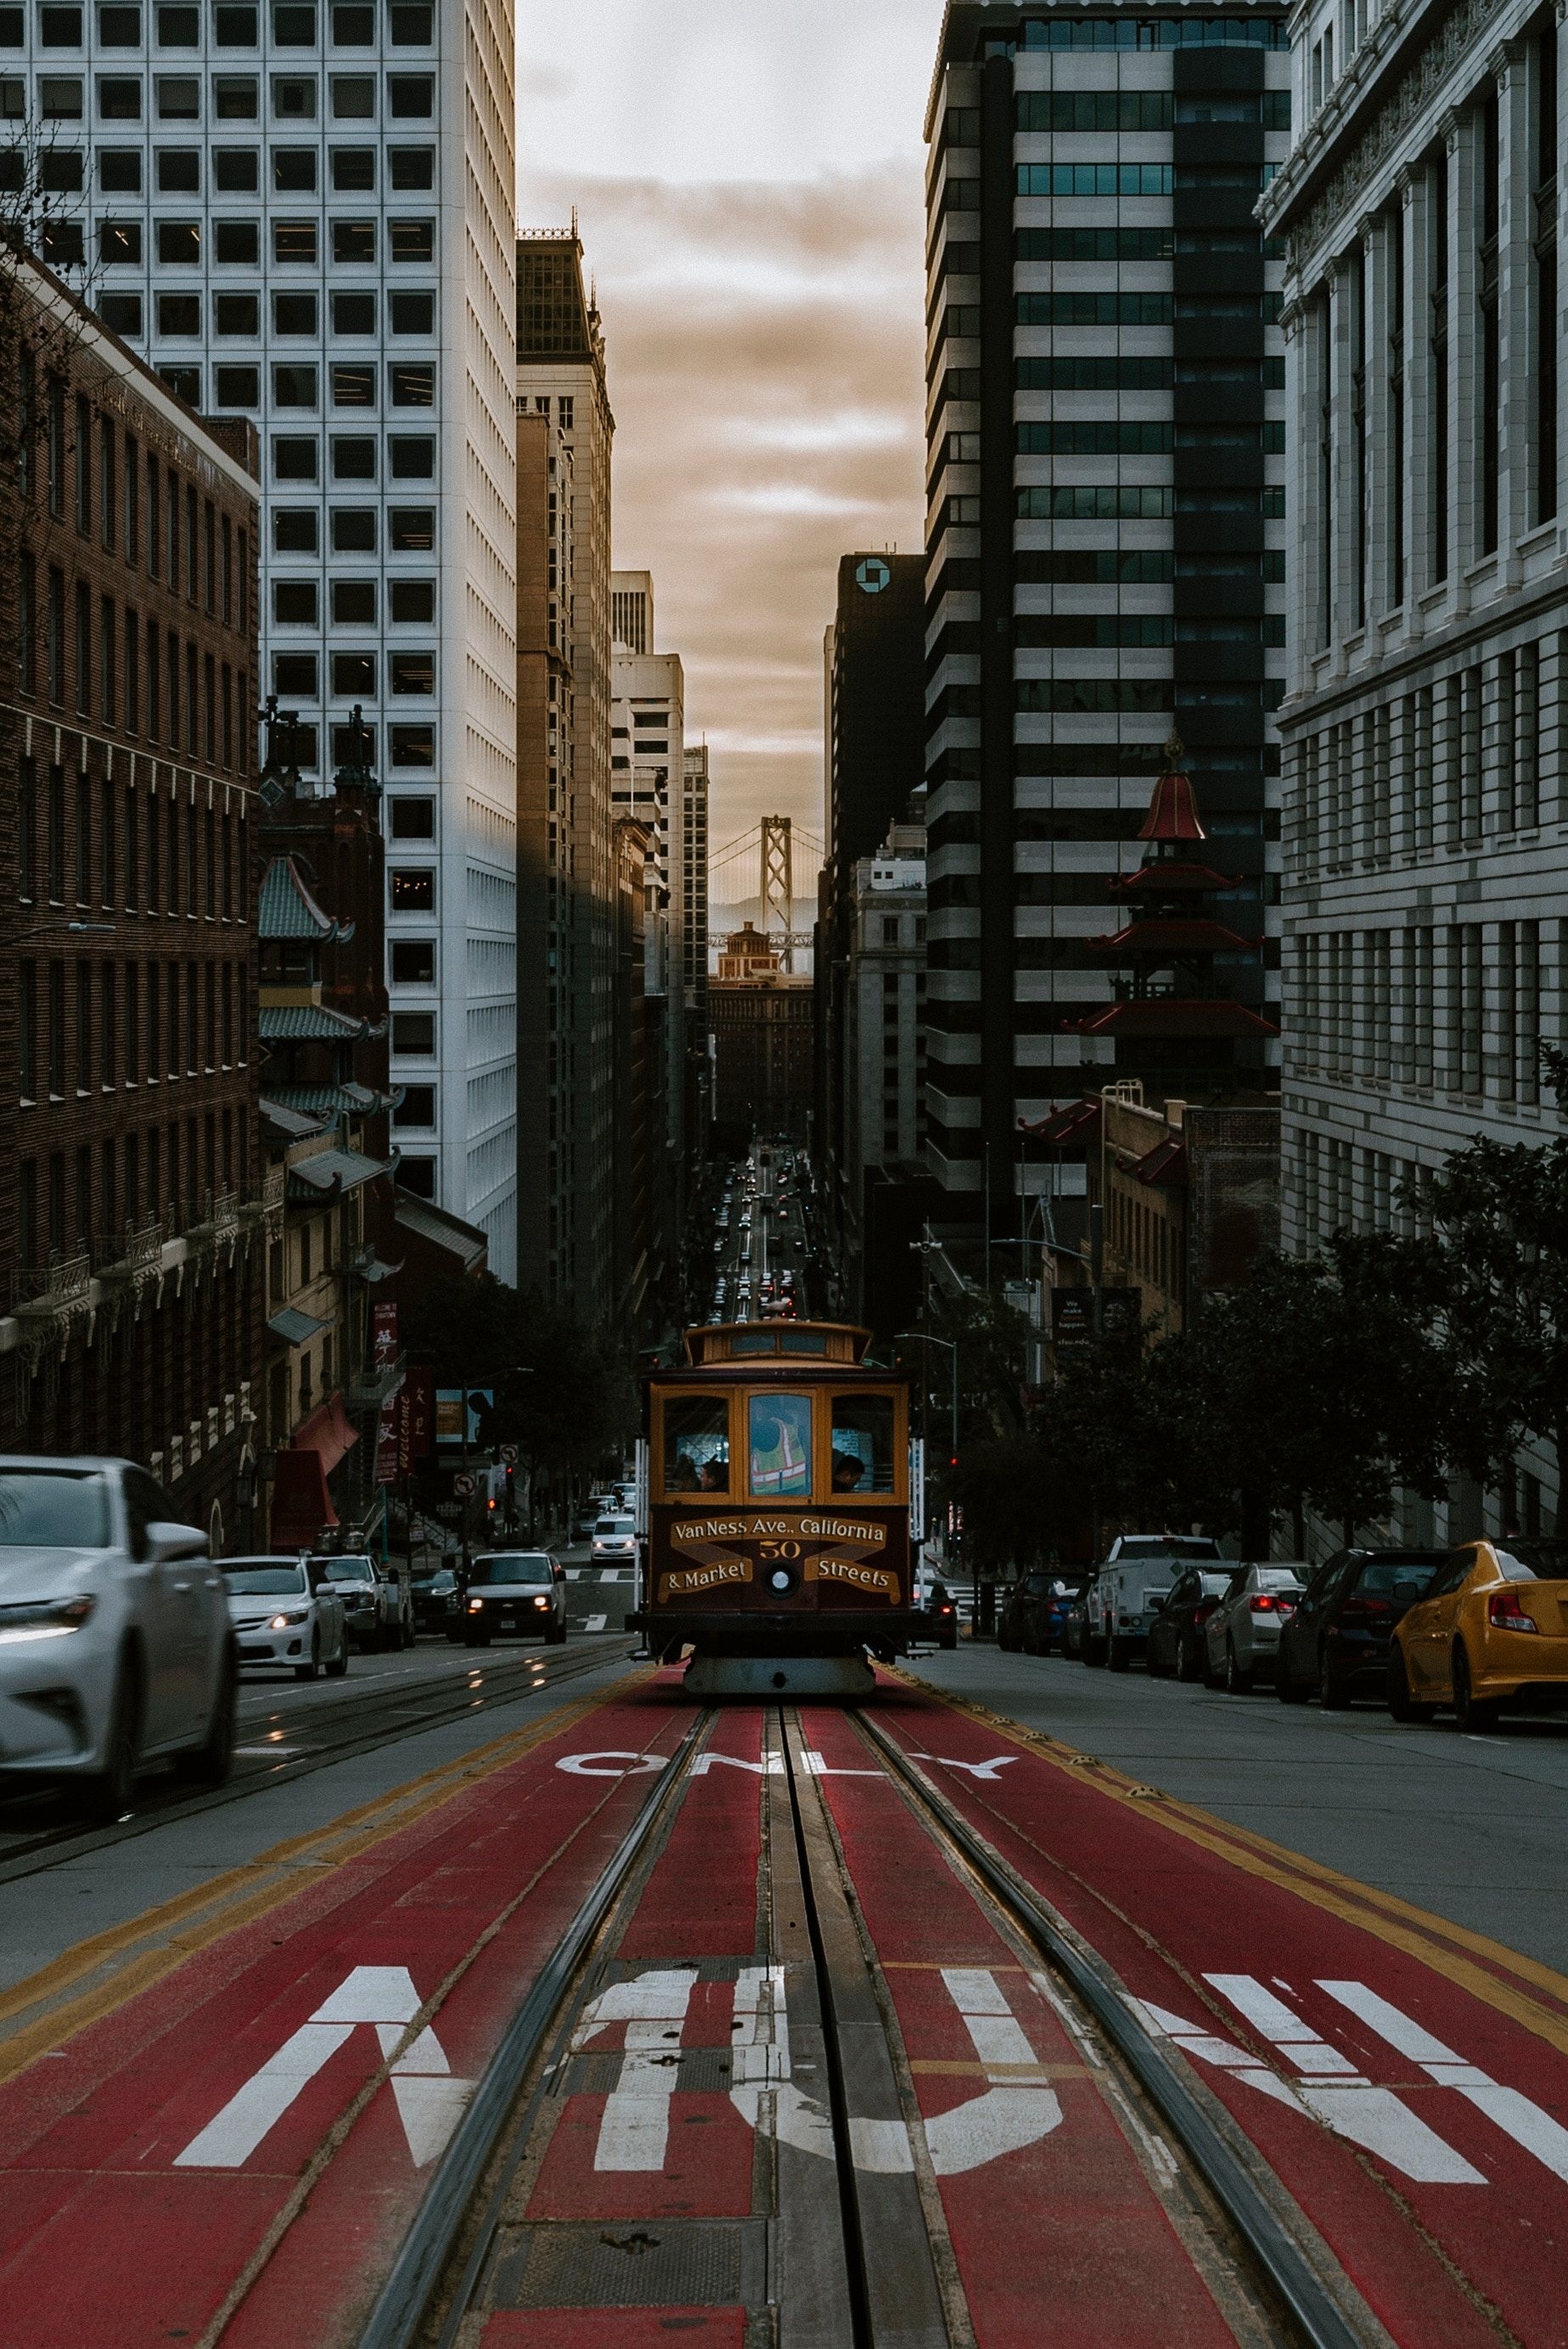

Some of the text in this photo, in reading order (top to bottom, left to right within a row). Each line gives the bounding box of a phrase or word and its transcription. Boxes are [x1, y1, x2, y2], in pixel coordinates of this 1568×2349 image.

[675, 1525, 704, 1540] Van
[706, 1520, 747, 1535] Ness
[801, 1518, 884, 1542] California
[760, 1541, 801, 1559] 50
[668, 1559, 890, 1589] & Market Streets
[554, 1751, 1020, 1780] ONLY
[172, 1962, 1568, 2185] MUNI
